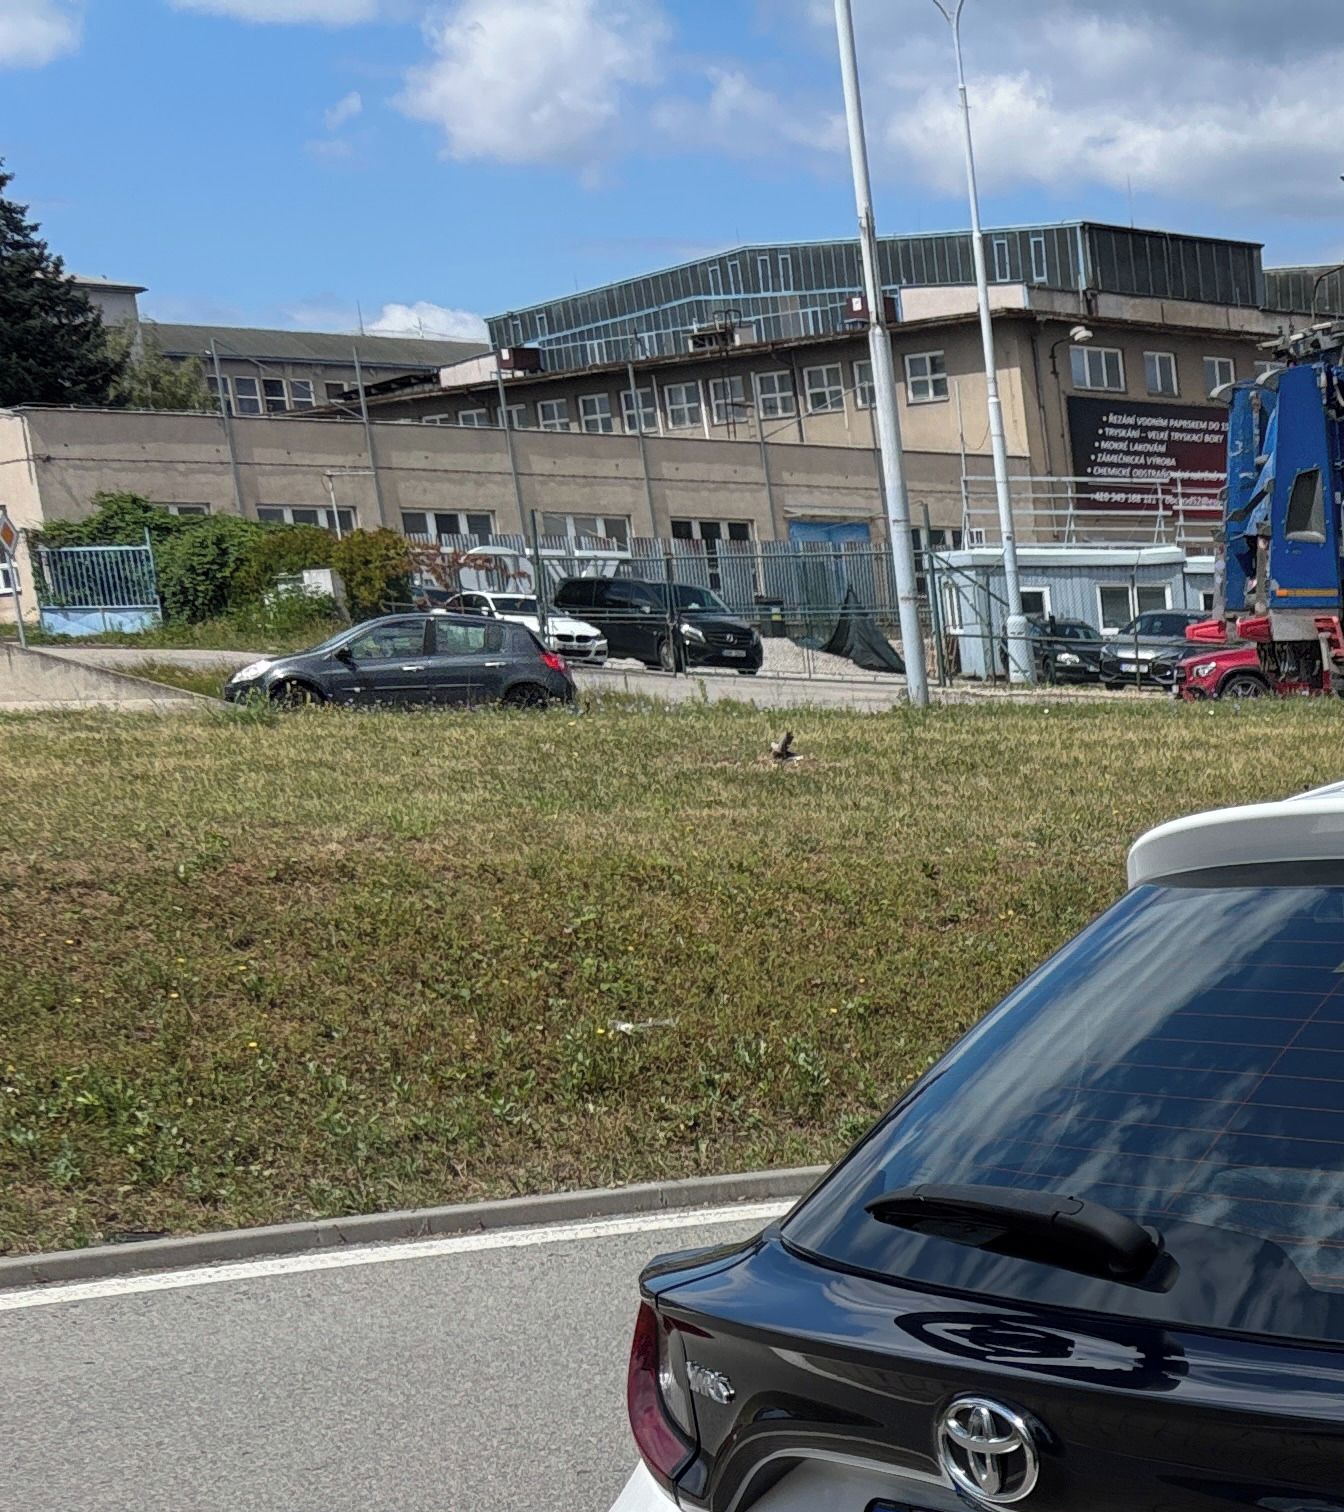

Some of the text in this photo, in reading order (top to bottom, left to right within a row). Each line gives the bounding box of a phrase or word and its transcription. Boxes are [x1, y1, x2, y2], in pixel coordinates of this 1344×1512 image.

[1108, 412, 1136, 425] ŘEZÁNÍ
[1169, 418, 1207, 430] PAPRSKEM
[1104, 426, 1141, 439] TRYSKÁNÍ
[1147, 429, 1170, 441] VELKÉ
[1170, 431, 1205, 443] TRYSKACÍ
[1101, 439, 1168, 453] MOKRÉ LAKOVÁNÍ
[1097, 452, 1177, 467] ZÁMEČNICKÁ VÝROBA
[1093, 466, 1131, 477] CHEMICKÉ
